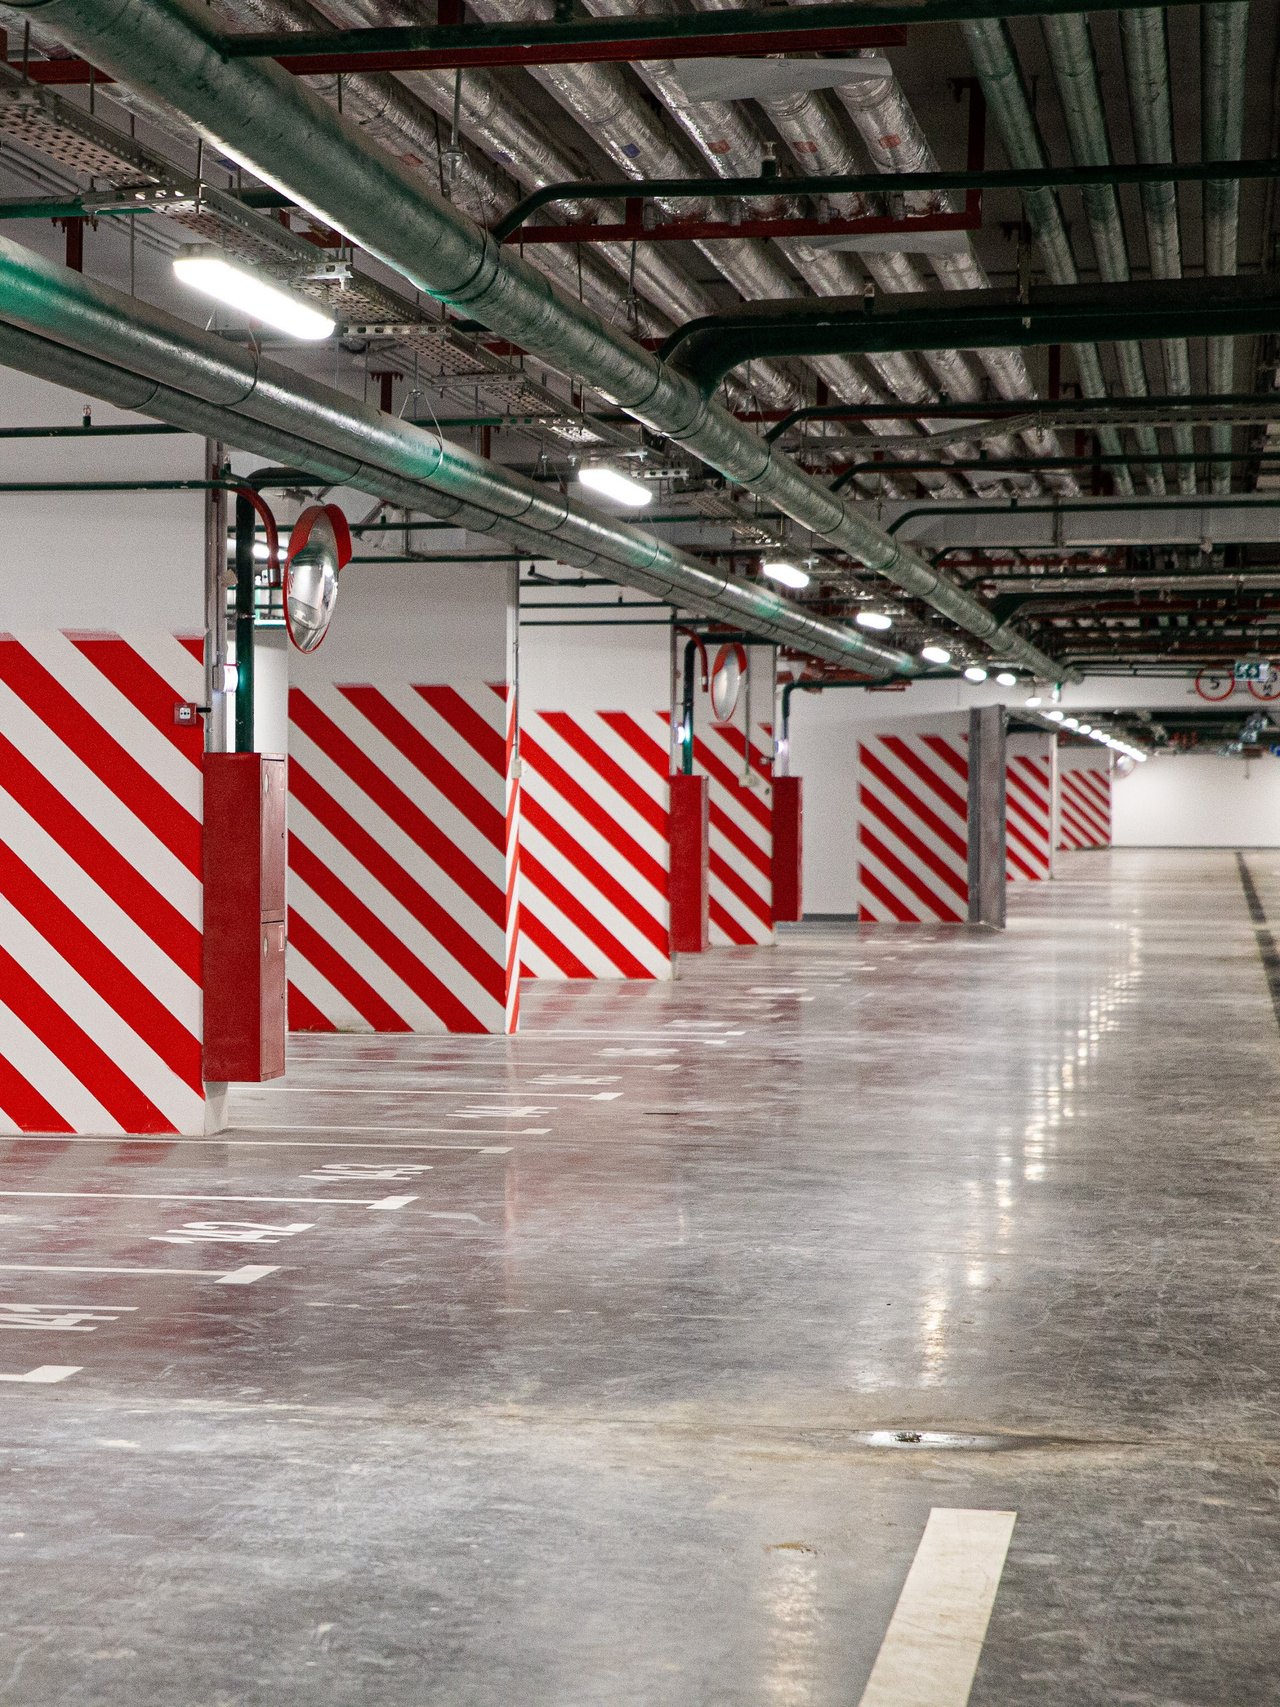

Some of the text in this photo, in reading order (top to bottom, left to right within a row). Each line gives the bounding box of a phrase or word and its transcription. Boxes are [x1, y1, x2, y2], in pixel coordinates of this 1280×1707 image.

[445, 1105, 559, 1118] 144
[298, 1163, 434, 1181] 143
[148, 1221, 316, 1244] 142
